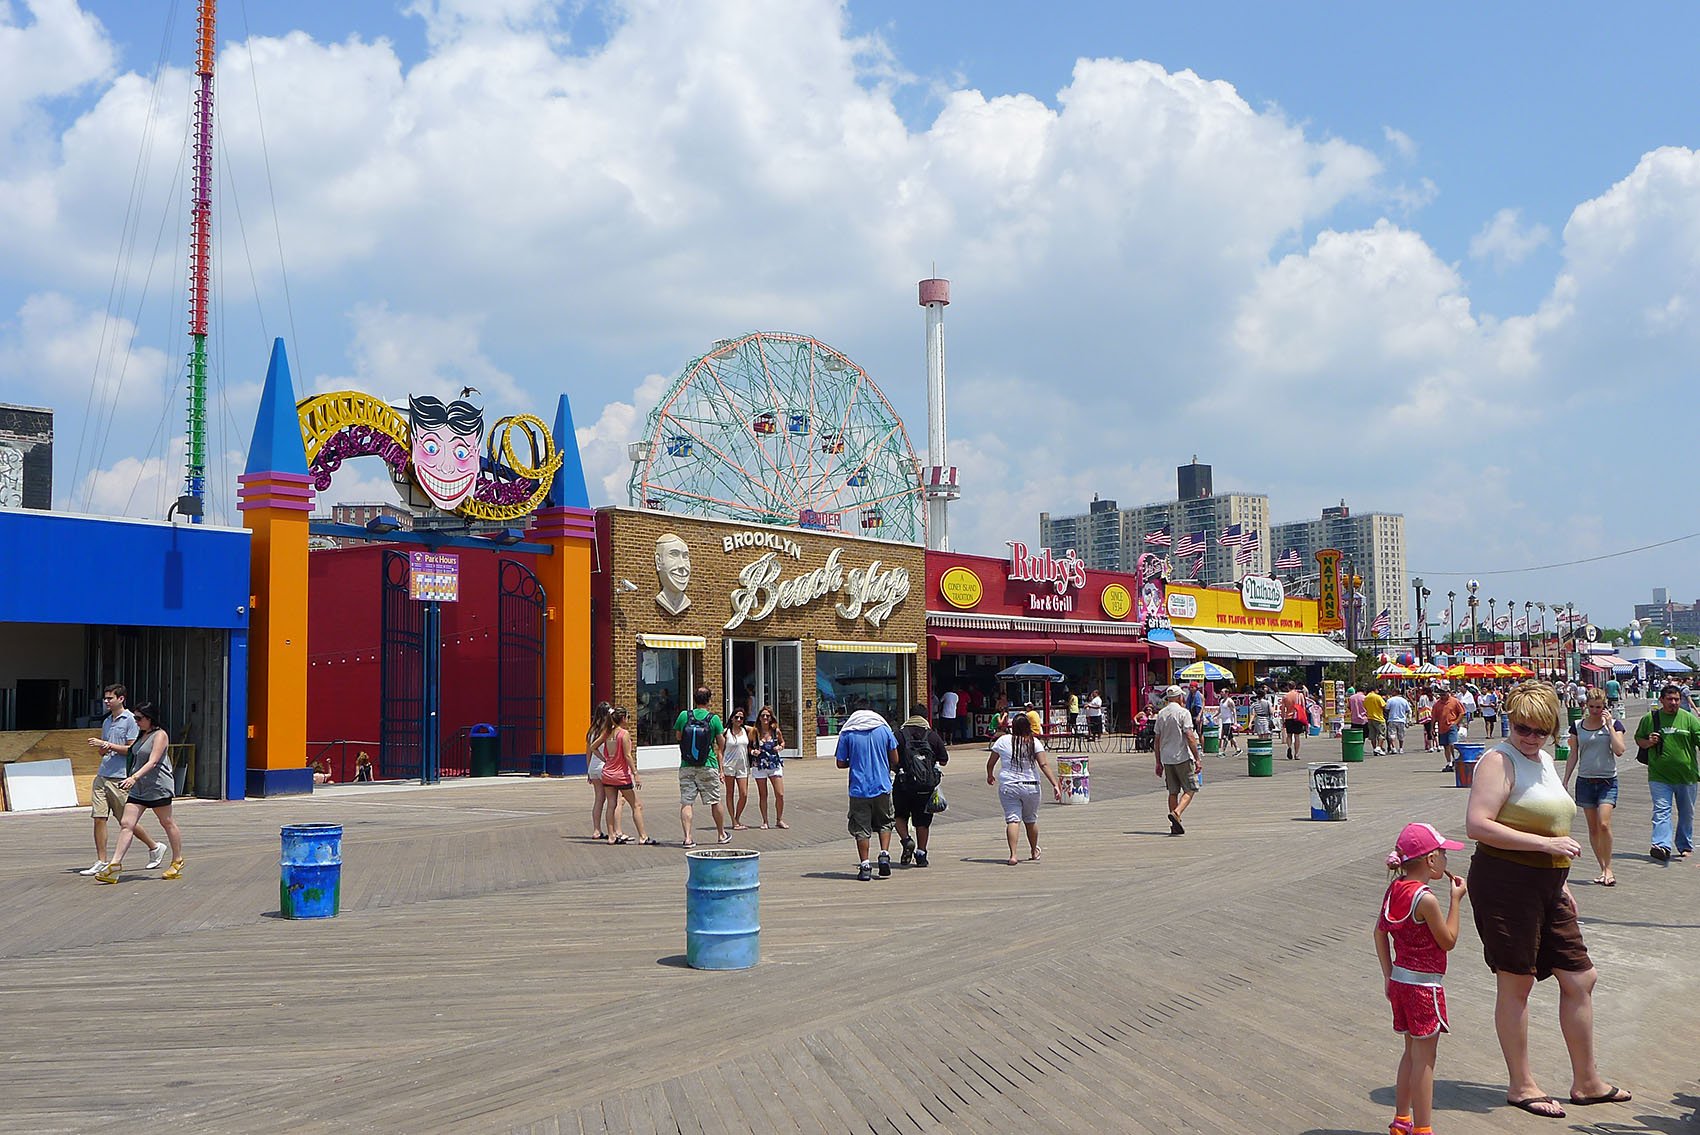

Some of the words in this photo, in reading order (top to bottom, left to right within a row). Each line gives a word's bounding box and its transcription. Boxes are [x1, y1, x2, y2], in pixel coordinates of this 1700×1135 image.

[800, 510, 840, 526] WONDER
[722, 531, 801, 561] BROOKLYN
[424, 554, 439, 564] Park
[439, 555, 457, 565] Hours
[1005, 541, 1087, 595] Ruby's
[723, 547, 845, 630] Beach
[834, 560, 911, 628] Shop
[947, 583, 962, 592] CONEY
[962, 583, 977, 593] ISLAND
[1110, 590, 1124, 601] SINCE
[1245, 577, 1281, 602] Nathan's
[1323, 556, 1335, 619] NATHANS
[952, 592, 974, 602] TRADITION
[1029, 594, 1046, 611] Bar
[1052, 594, 1073, 612] Grill
[1112, 601, 1123, 612] 1934
[1216, 613, 1227, 623] THE
[1228, 614, 1247, 625] FLAVOR
[1247, 616, 1254, 625] OF
[1255, 616, 1266, 626] NEW
[1267, 617, 1279, 627] YORK
